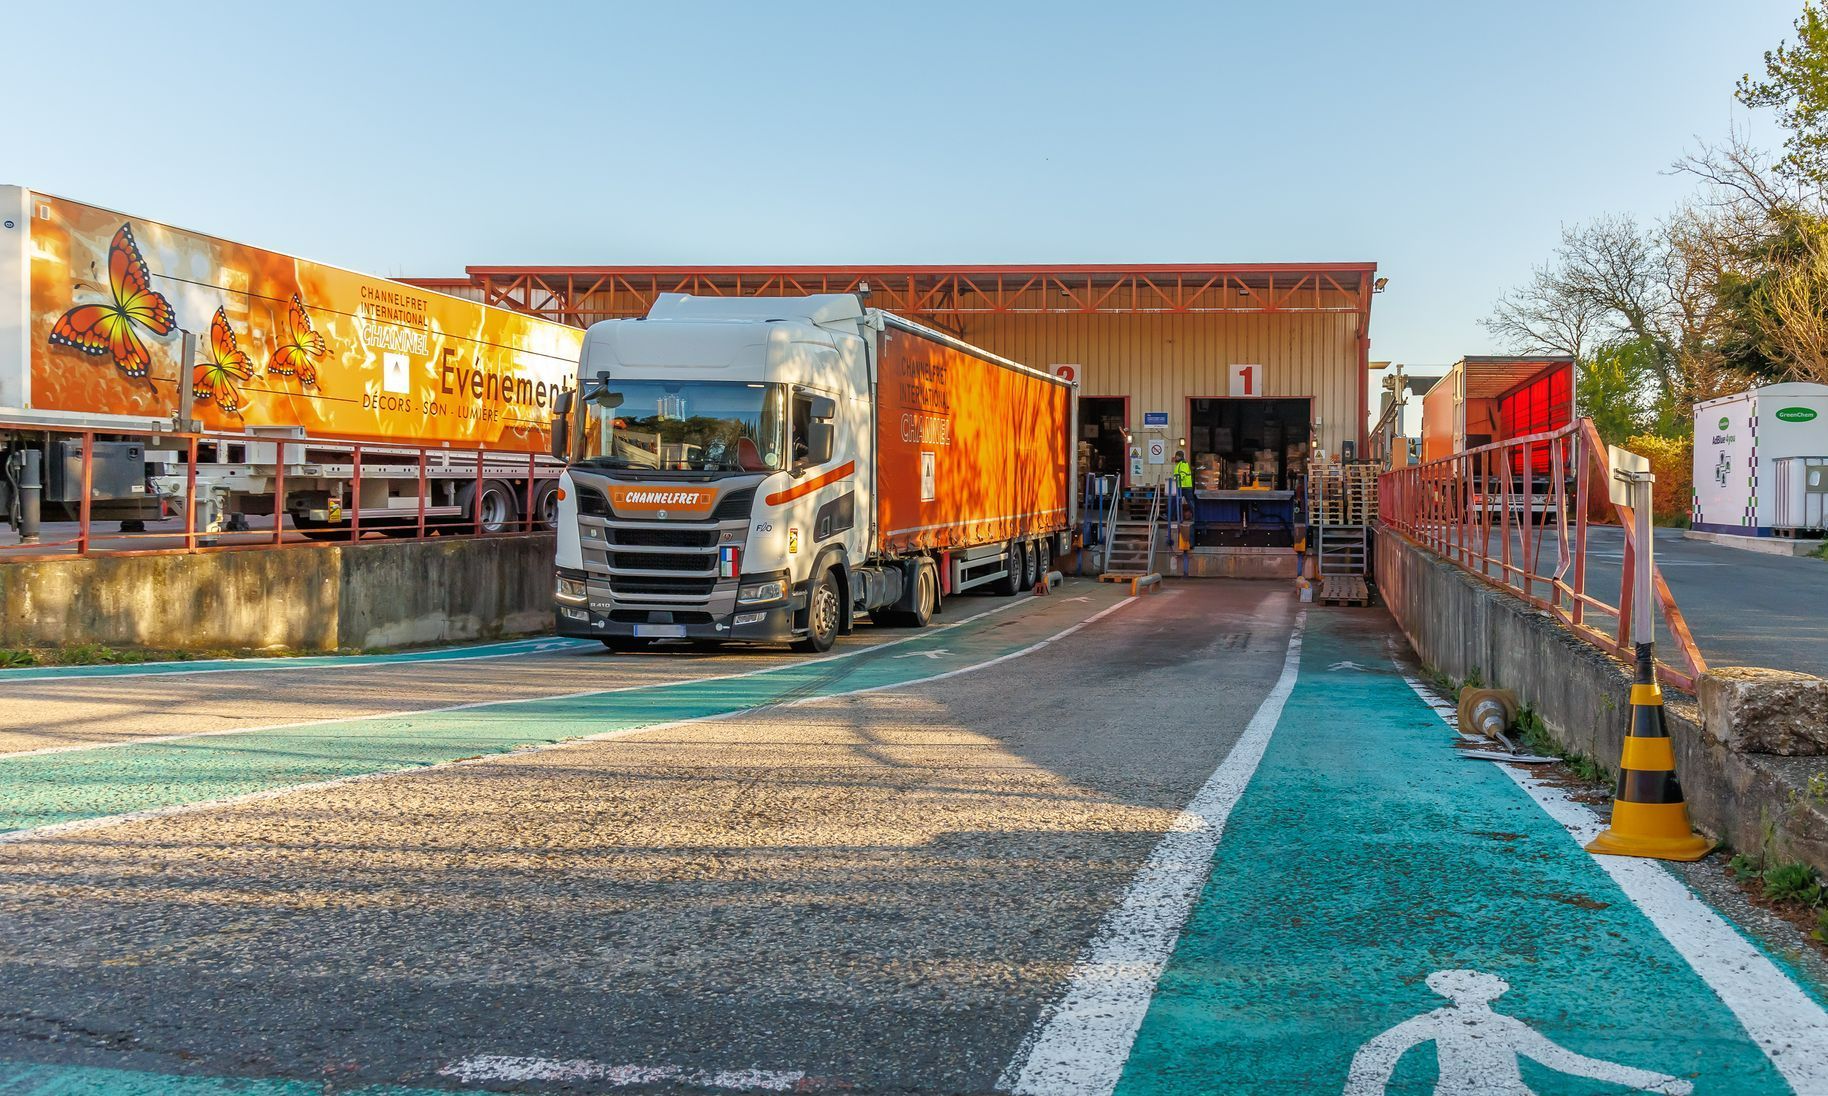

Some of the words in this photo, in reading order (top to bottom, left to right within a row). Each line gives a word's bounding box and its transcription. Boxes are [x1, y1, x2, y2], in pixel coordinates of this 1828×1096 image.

[360, 286, 428, 312] CHANNELFRET
[360, 302, 428, 327] INTERNATIONAL
[362, 323, 429, 356] CHANNEL
[901, 357, 948, 385] CHANNELFRET
[1239, 366, 1253, 395] 1
[362, 392, 411, 413] DÉCORS
[423, 401, 447, 416] SON
[458, 405, 498, 422] LUMIÈRE
[899, 384, 950, 410] INTERNATIONAL
[900, 413, 951, 446] CHANNEL
[625, 491, 699, 505] CHANNELFRET
